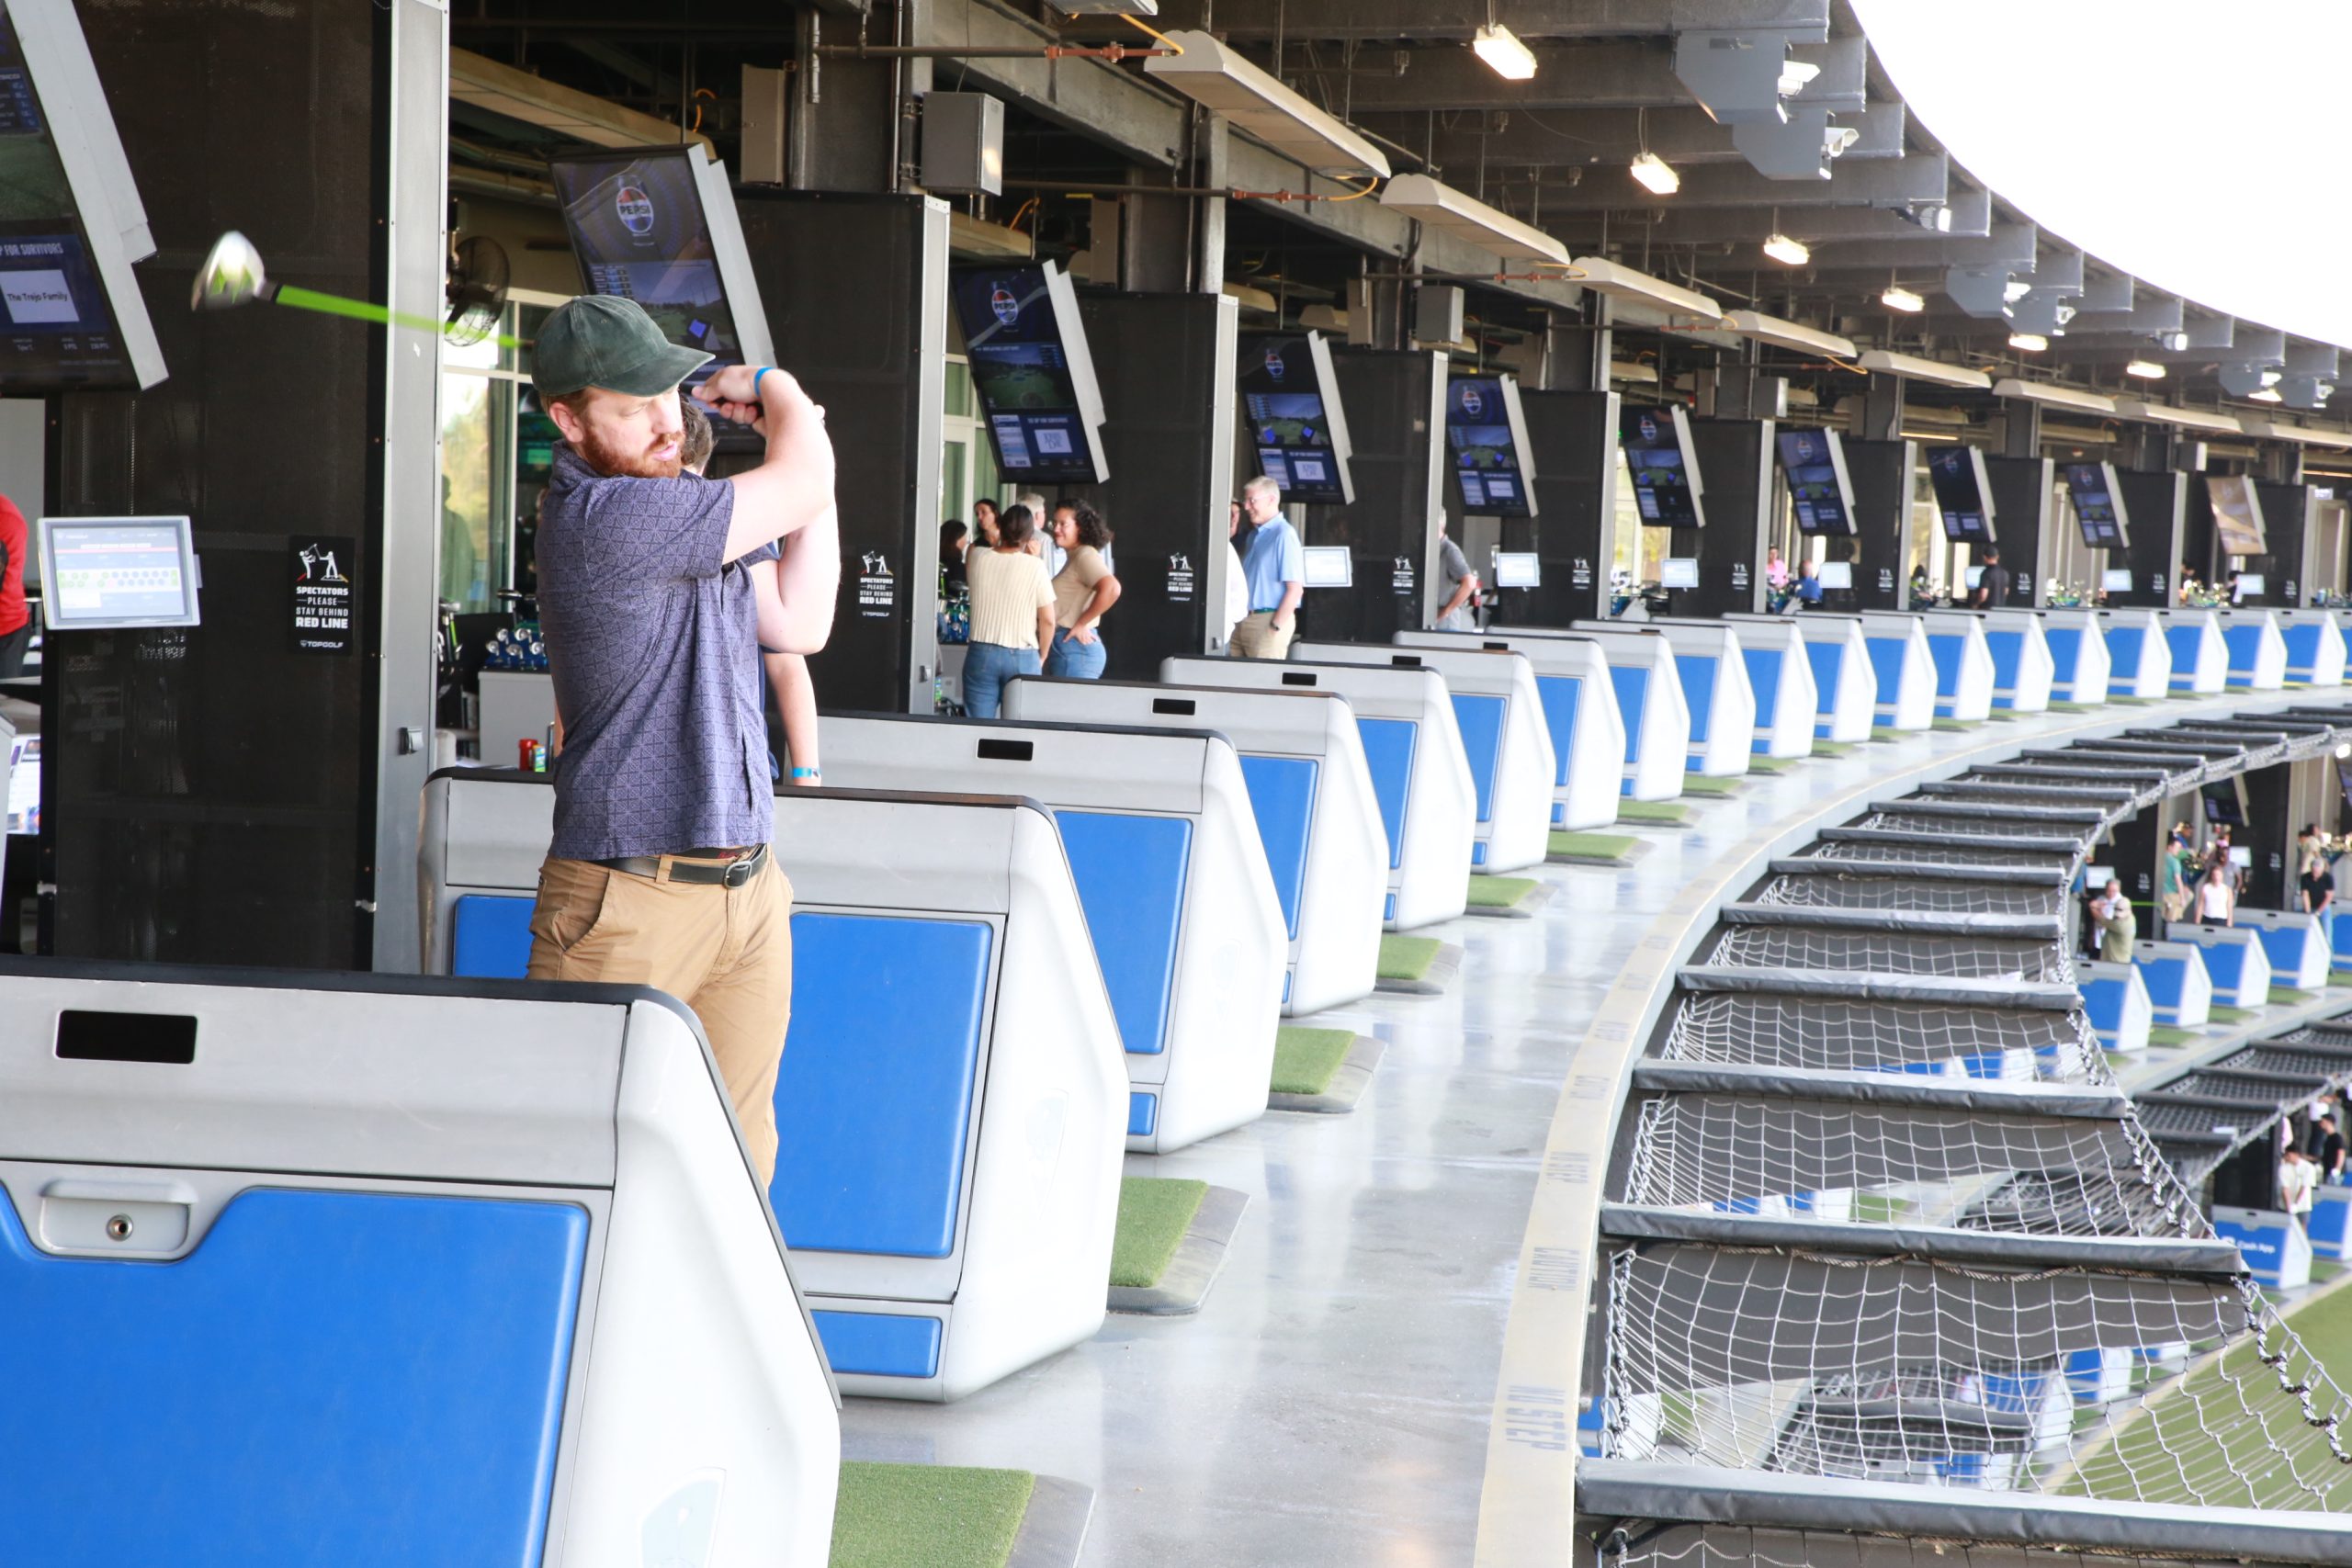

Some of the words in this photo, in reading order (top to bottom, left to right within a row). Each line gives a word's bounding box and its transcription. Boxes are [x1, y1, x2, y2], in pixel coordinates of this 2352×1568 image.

[619, 205, 650, 215] PEPSI
[20, 243, 64, 255] SURVIVORS
[7, 293, 22, 301] The
[43, 291, 68, 302] Family
[296, 586, 348, 596] SPECTATORS
[307, 597, 337, 606] PLEASE
[859, 596, 875, 604] RED
[295, 606, 315, 615] STAY
[318, 607, 348, 616] BEHIND
[295, 616, 319, 628] RED
[321, 617, 348, 629] LINE
[307, 640, 344, 649] TOPGOLF
